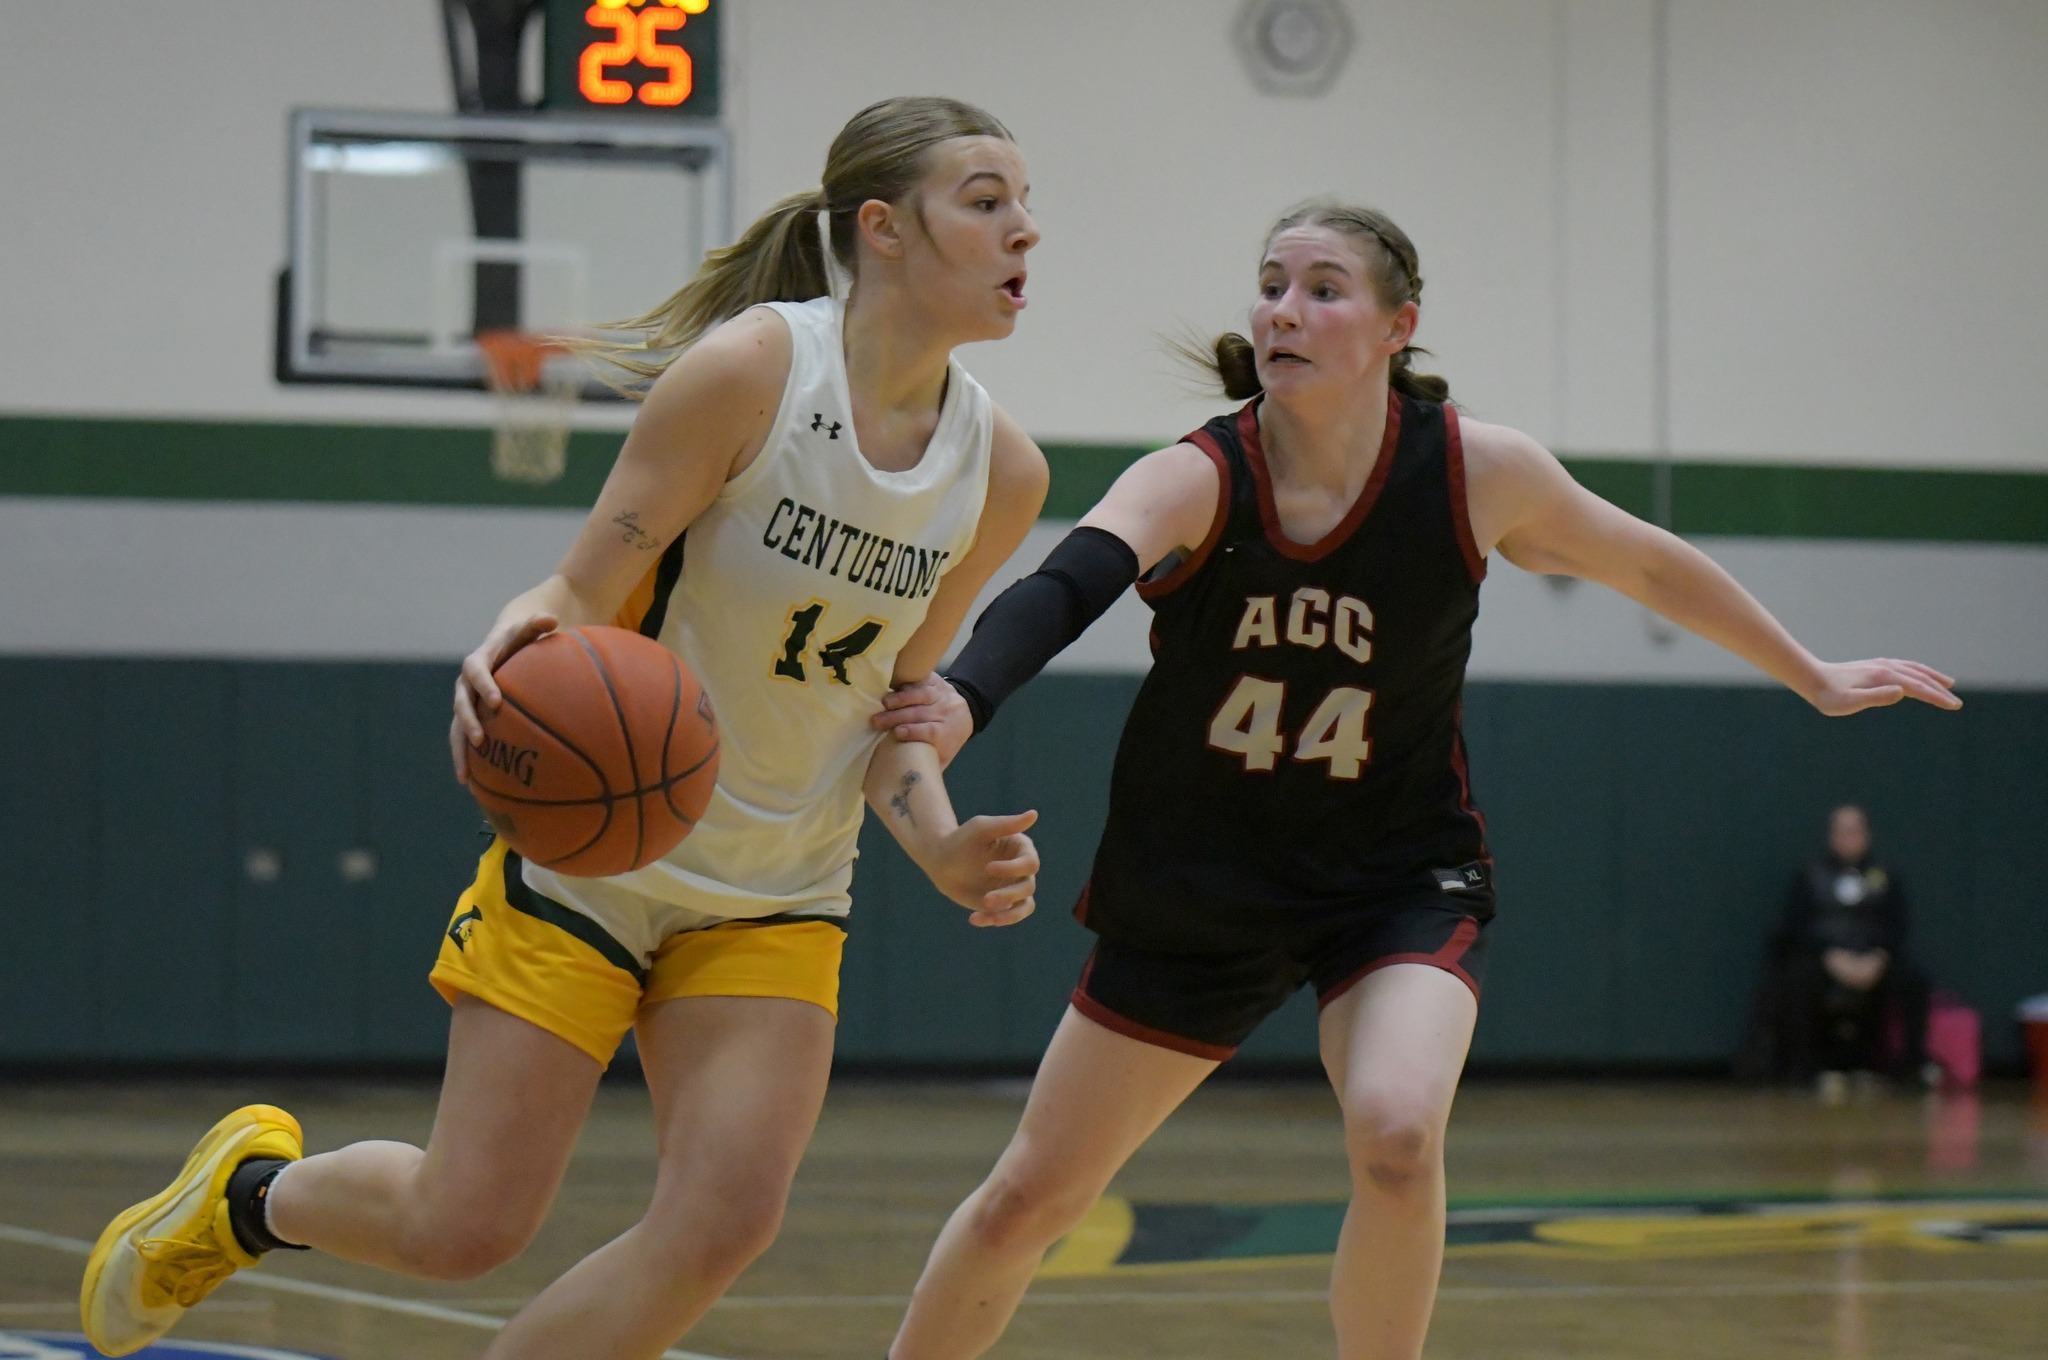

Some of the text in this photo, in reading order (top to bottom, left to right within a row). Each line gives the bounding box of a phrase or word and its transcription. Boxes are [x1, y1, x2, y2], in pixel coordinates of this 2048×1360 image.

[579, 4, 692, 106] 25
[769, 597, 889, 686] 14
[1232, 586, 1374, 664] ACC
[1208, 673, 1375, 780] 44
[1464, 869, 1482, 882] XL
